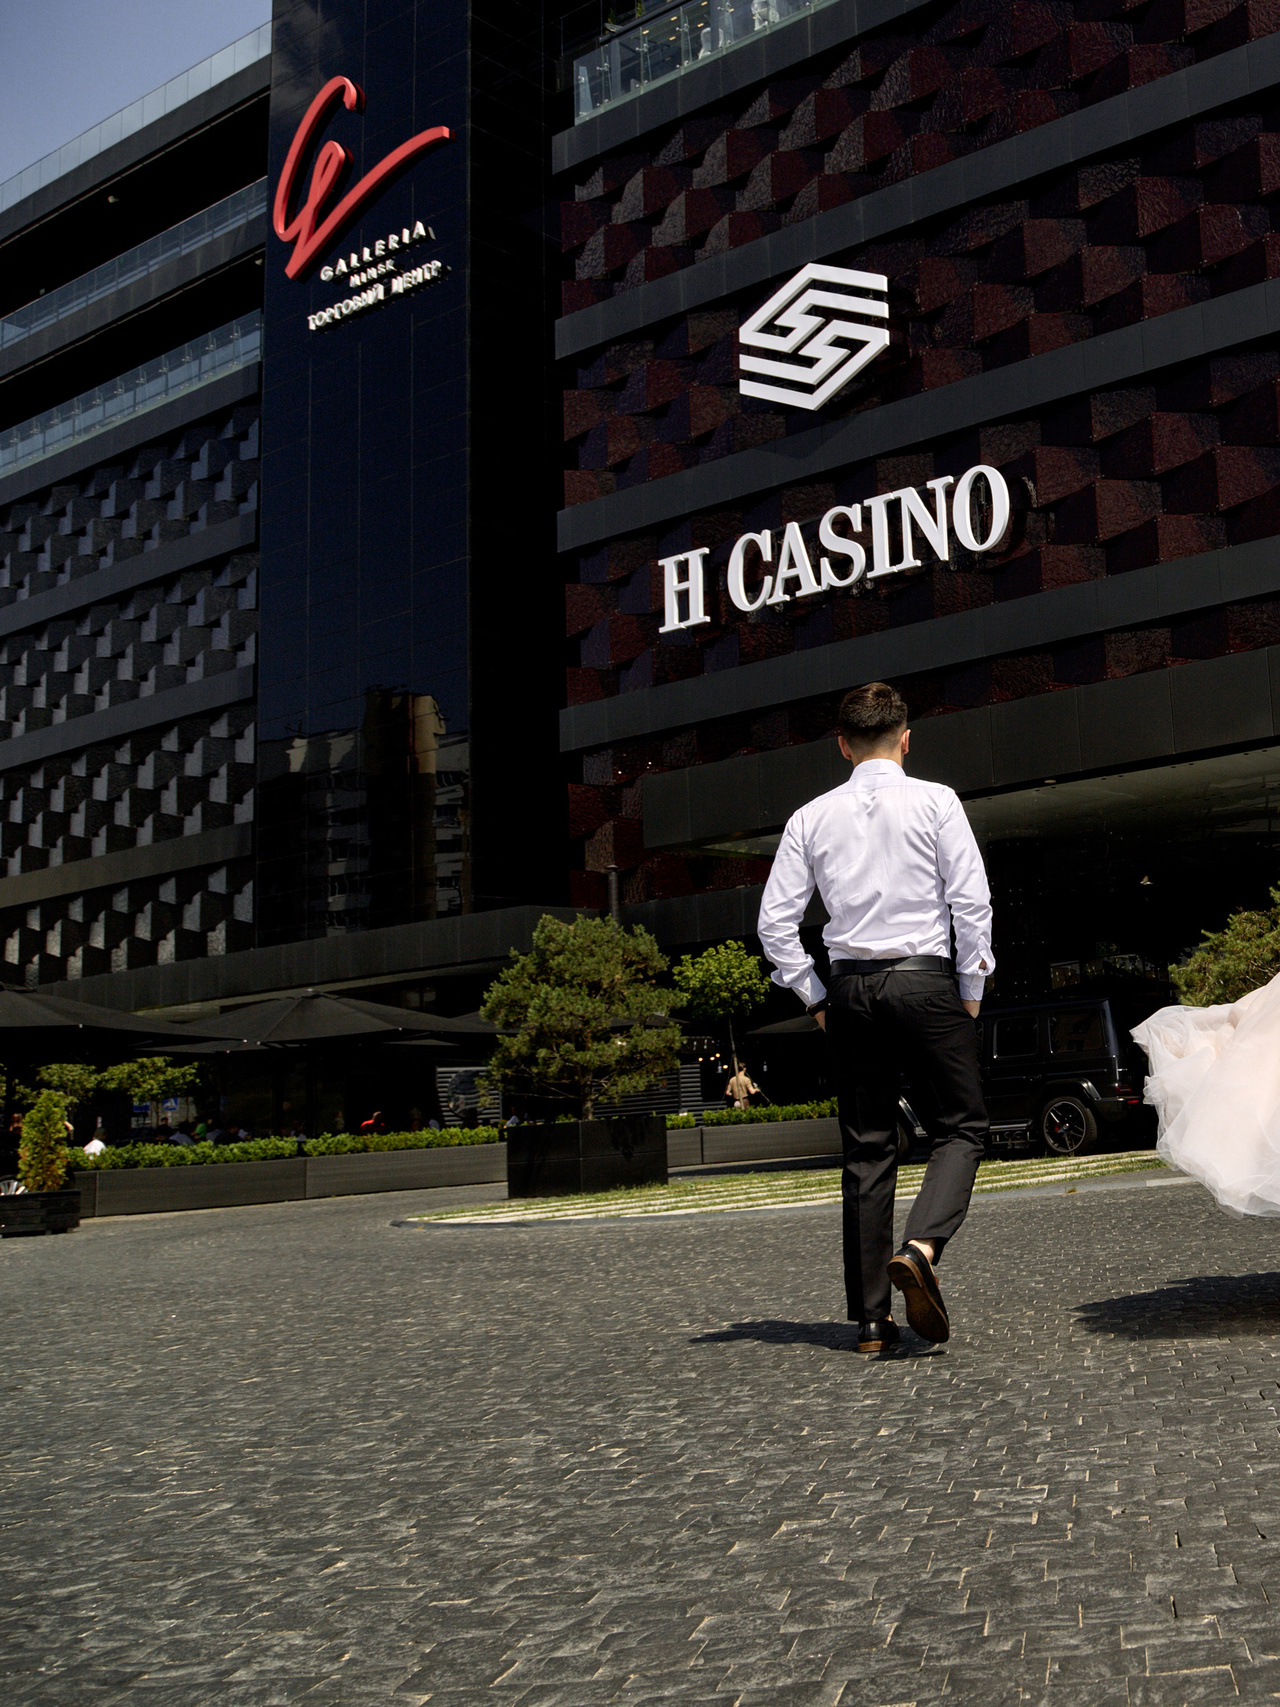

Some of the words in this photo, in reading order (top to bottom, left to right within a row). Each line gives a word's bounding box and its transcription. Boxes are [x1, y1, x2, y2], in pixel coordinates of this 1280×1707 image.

[319, 220, 427, 282] GALLERIA
[348, 258, 396, 288] MINSK
[306, 282, 385, 331] ТОРГОВЫЙ
[390, 259, 442, 294] ЦЕНТР
[657, 546, 711, 634] H
[727, 464, 1010, 612] CASINO
